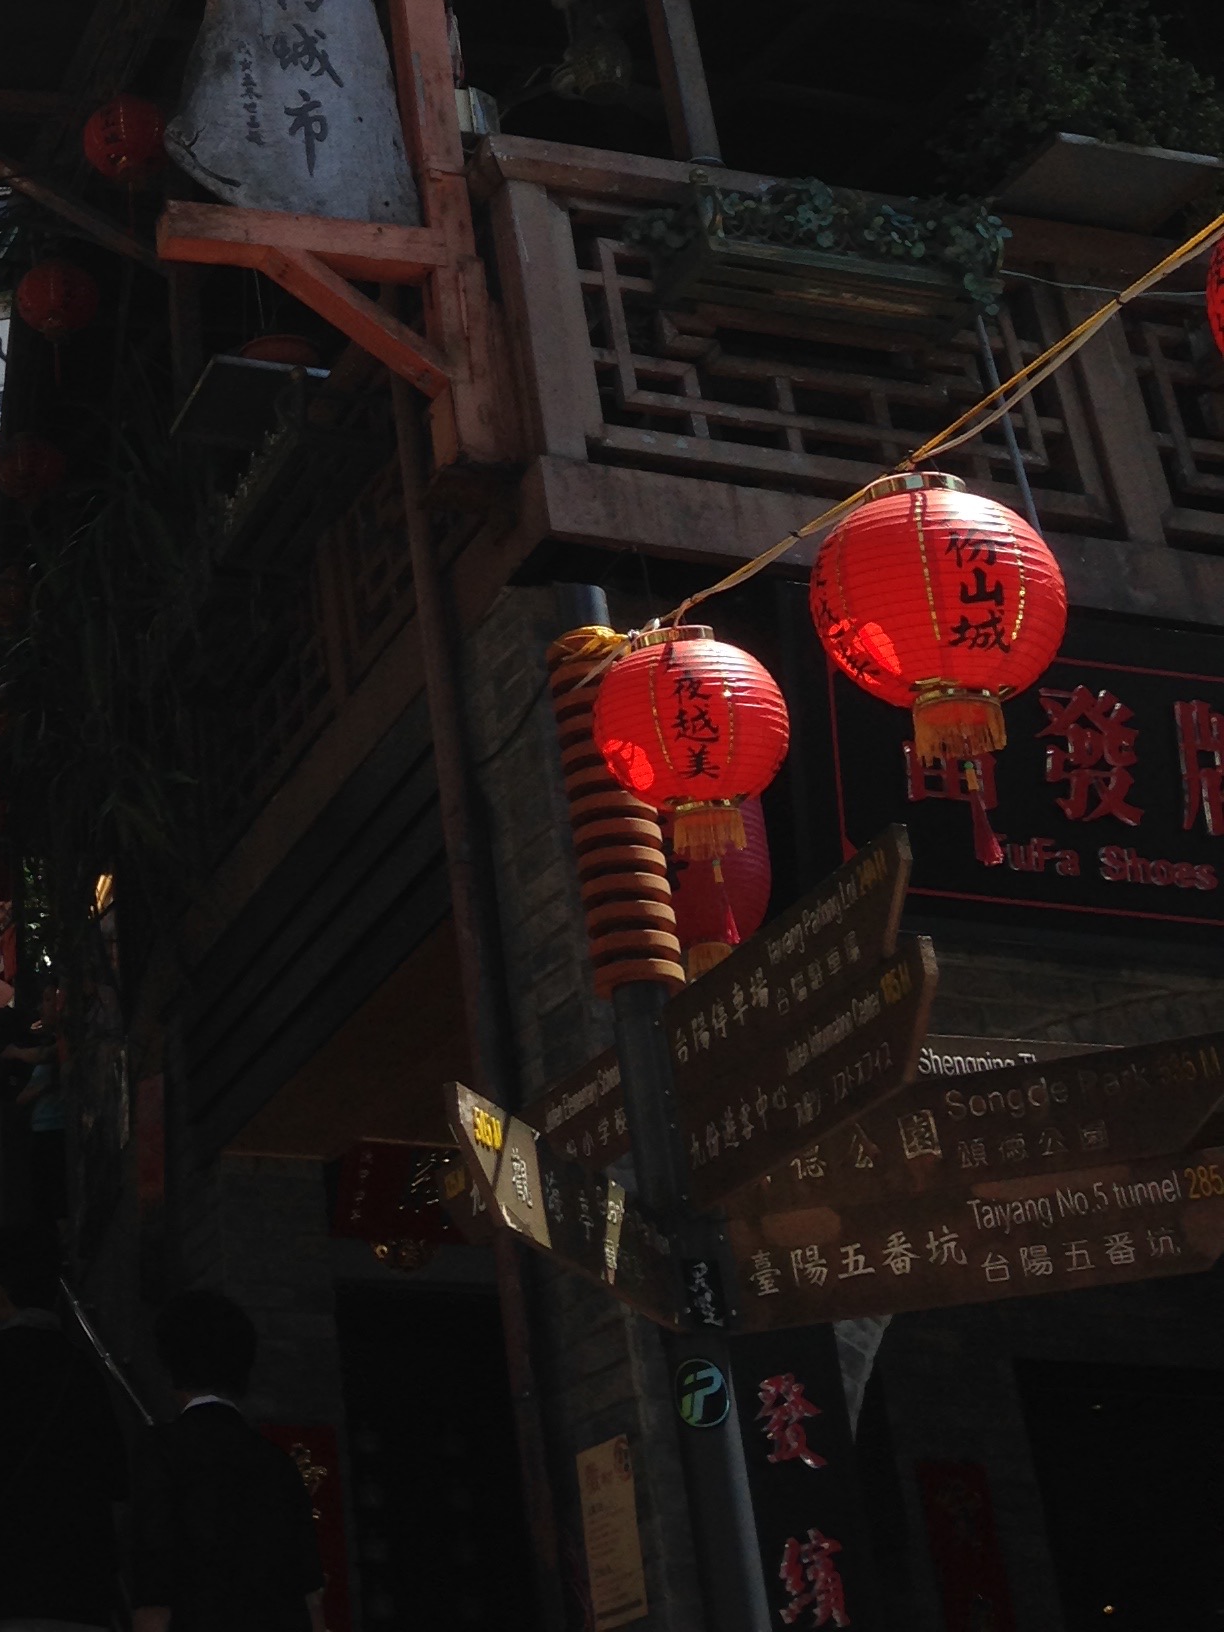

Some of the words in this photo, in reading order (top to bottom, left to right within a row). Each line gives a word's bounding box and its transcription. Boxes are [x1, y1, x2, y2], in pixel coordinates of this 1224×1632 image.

[1098, 844, 1218, 891] Shoes
[944, 1078, 1070, 1121] Songde
[967, 1197, 1054, 1235] Taiyang
[1113, 1170, 1183, 1207] tunnel
[748, 1225, 969, 1299] 臺陽五番坑
[980, 1226, 1181, 1284] 台陽五番坑
